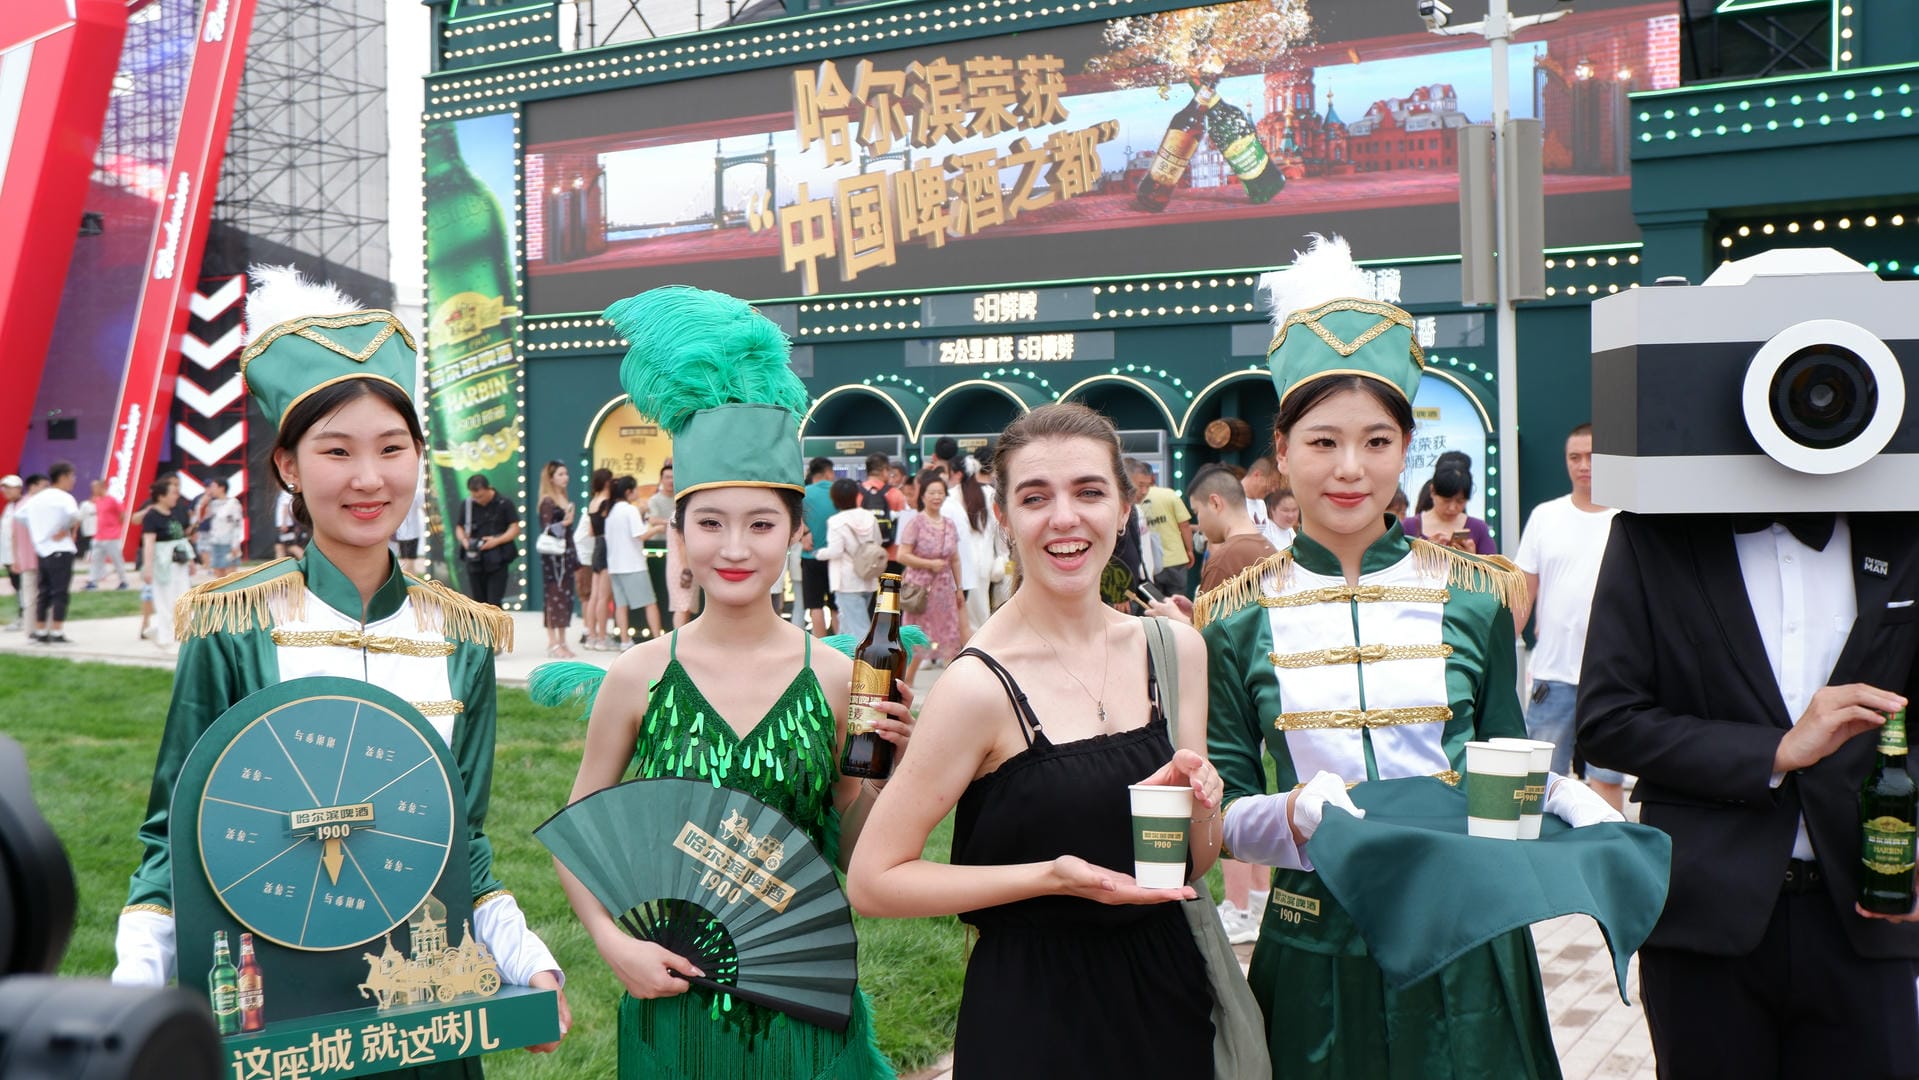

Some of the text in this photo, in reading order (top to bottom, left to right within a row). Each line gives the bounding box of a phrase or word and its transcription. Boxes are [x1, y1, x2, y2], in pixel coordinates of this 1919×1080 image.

[792, 53, 1069, 168] 哈尔滨荣获
[1864, 563, 1888, 575] MAN
[294, 729, 336, 748] 谢谢参与
[365, 744, 395, 762] 三等奖
[241, 766, 272, 782] 一等奖
[296, 806, 369, 824] 哈尔滨啤酒
[398, 800, 428, 816] 二等奖
[225, 827, 259, 844] 二等奖
[318, 823, 350, 840] 1900
[1154, 840, 1172, 849] 1900
[384, 857, 414, 873] 一等奖
[683, 829, 787, 904] 哈尔滨啤酒
[263, 881, 295, 898] 三等奖
[700, 869, 743, 904] 1900
[324, 892, 366, 910] 谢谢参与
[232, 1007, 499, 1080] 这座城 就这味儿
